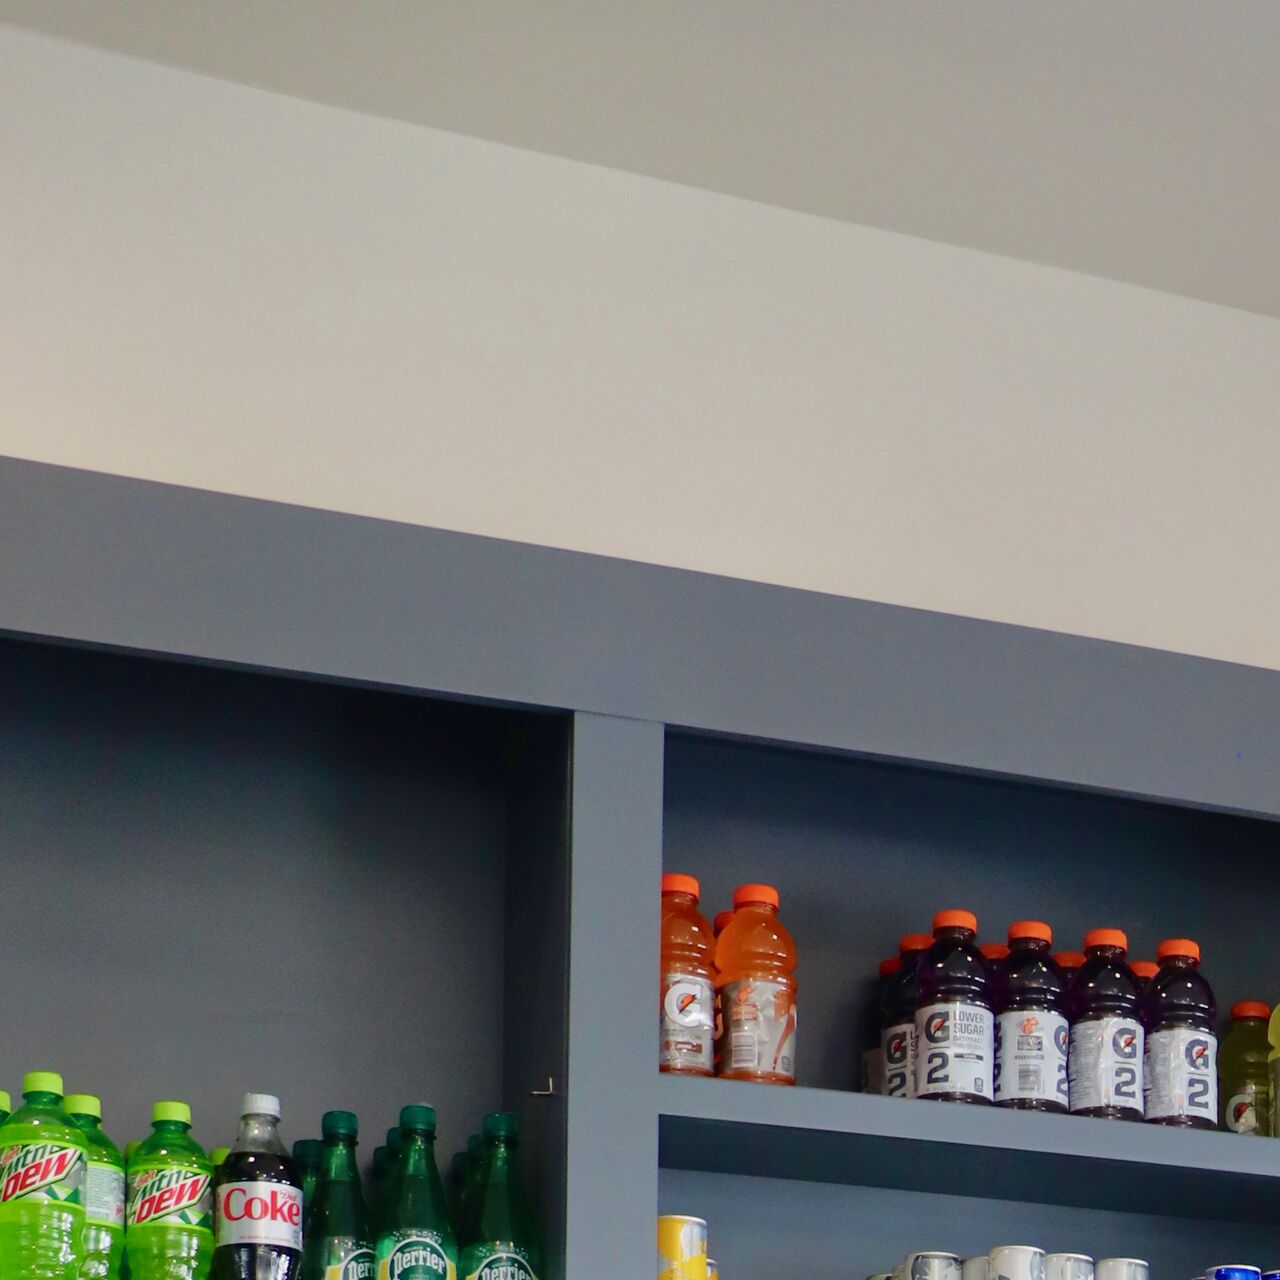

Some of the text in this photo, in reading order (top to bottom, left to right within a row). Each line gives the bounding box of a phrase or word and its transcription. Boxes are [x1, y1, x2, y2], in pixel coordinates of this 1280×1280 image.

[925, 1011, 950, 1043] G
[953, 1010, 984, 1024] LOWER
[953, 1023, 984, 1036] SUGAR
[1112, 1029, 1137, 1058] G
[1185, 1039, 1209, 1069] G
[928, 1052, 949, 1084] 2
[1115, 1069, 1137, 1098] 2
[1188, 1080, 1209, 1109] 2
[224, 1188, 299, 1226] Coke
